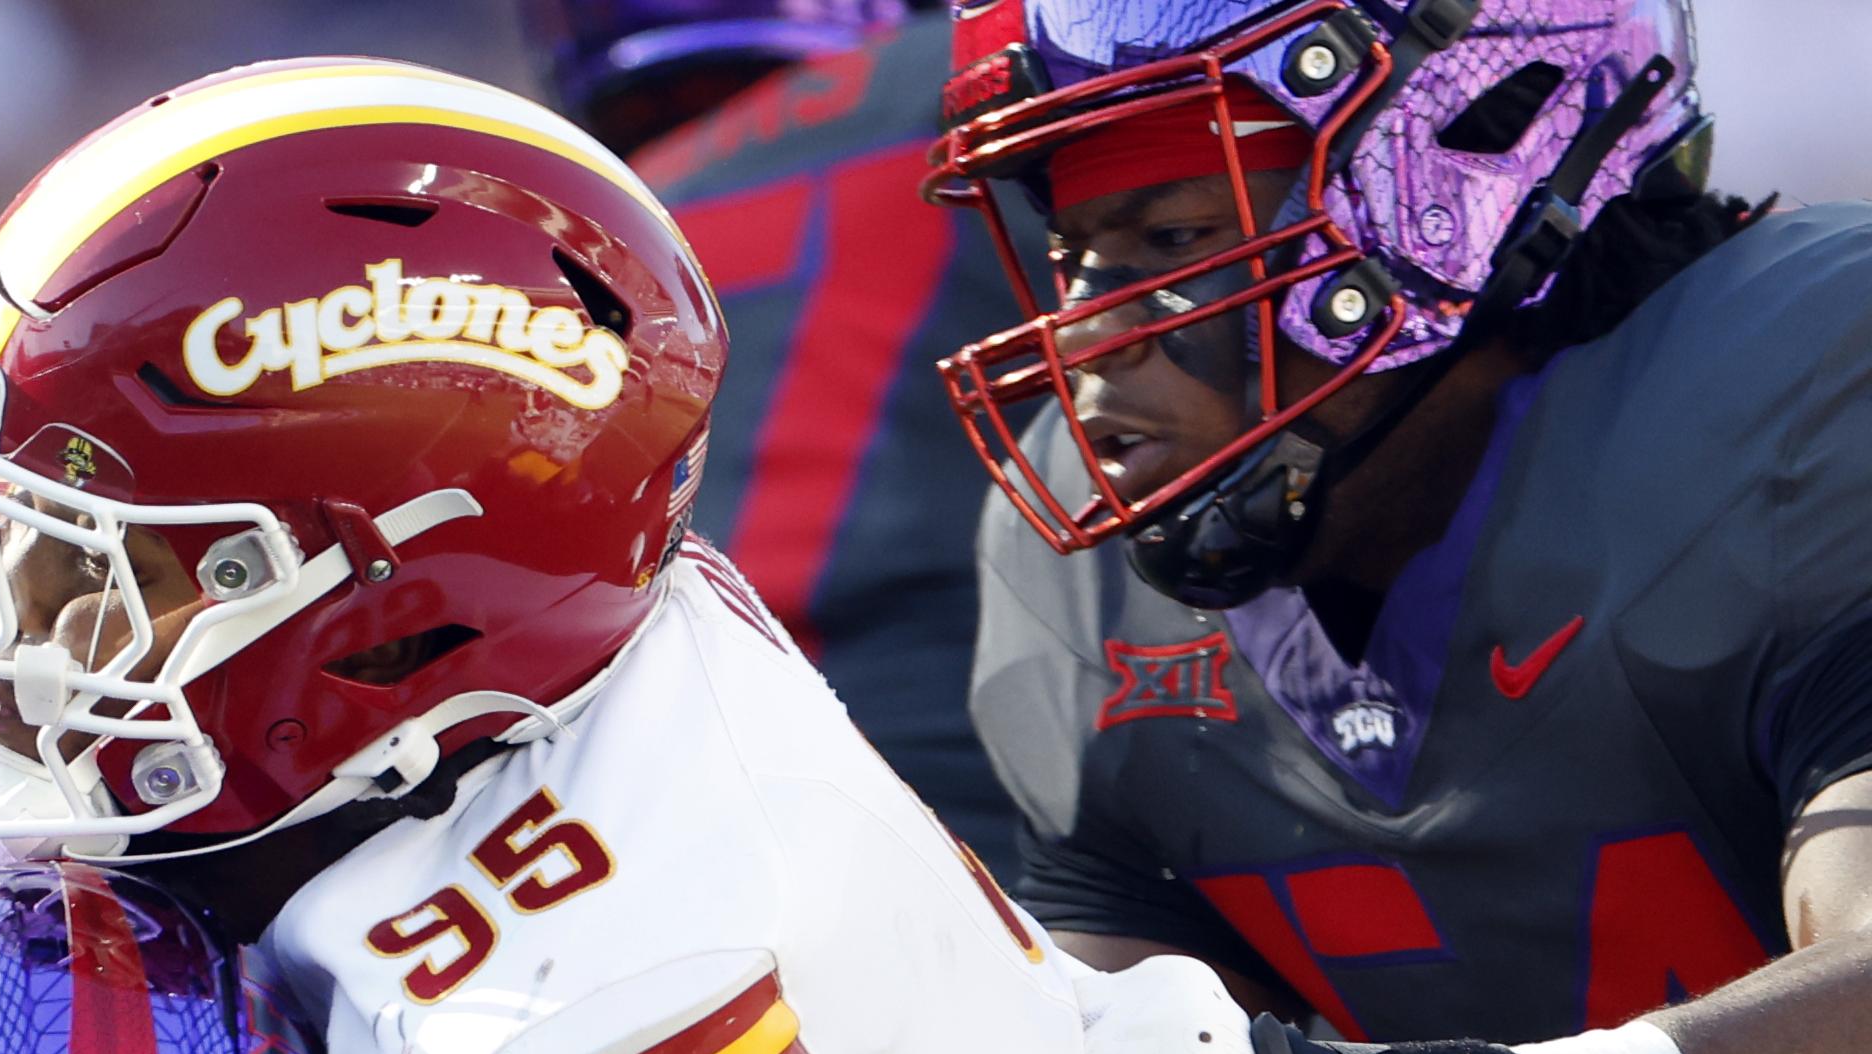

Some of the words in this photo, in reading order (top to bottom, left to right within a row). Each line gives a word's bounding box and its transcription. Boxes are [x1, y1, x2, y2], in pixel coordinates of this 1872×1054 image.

[183, 259, 630, 410] Cyclones
[1332, 704, 1397, 752] TCU
[362, 785, 618, 1006] 95
